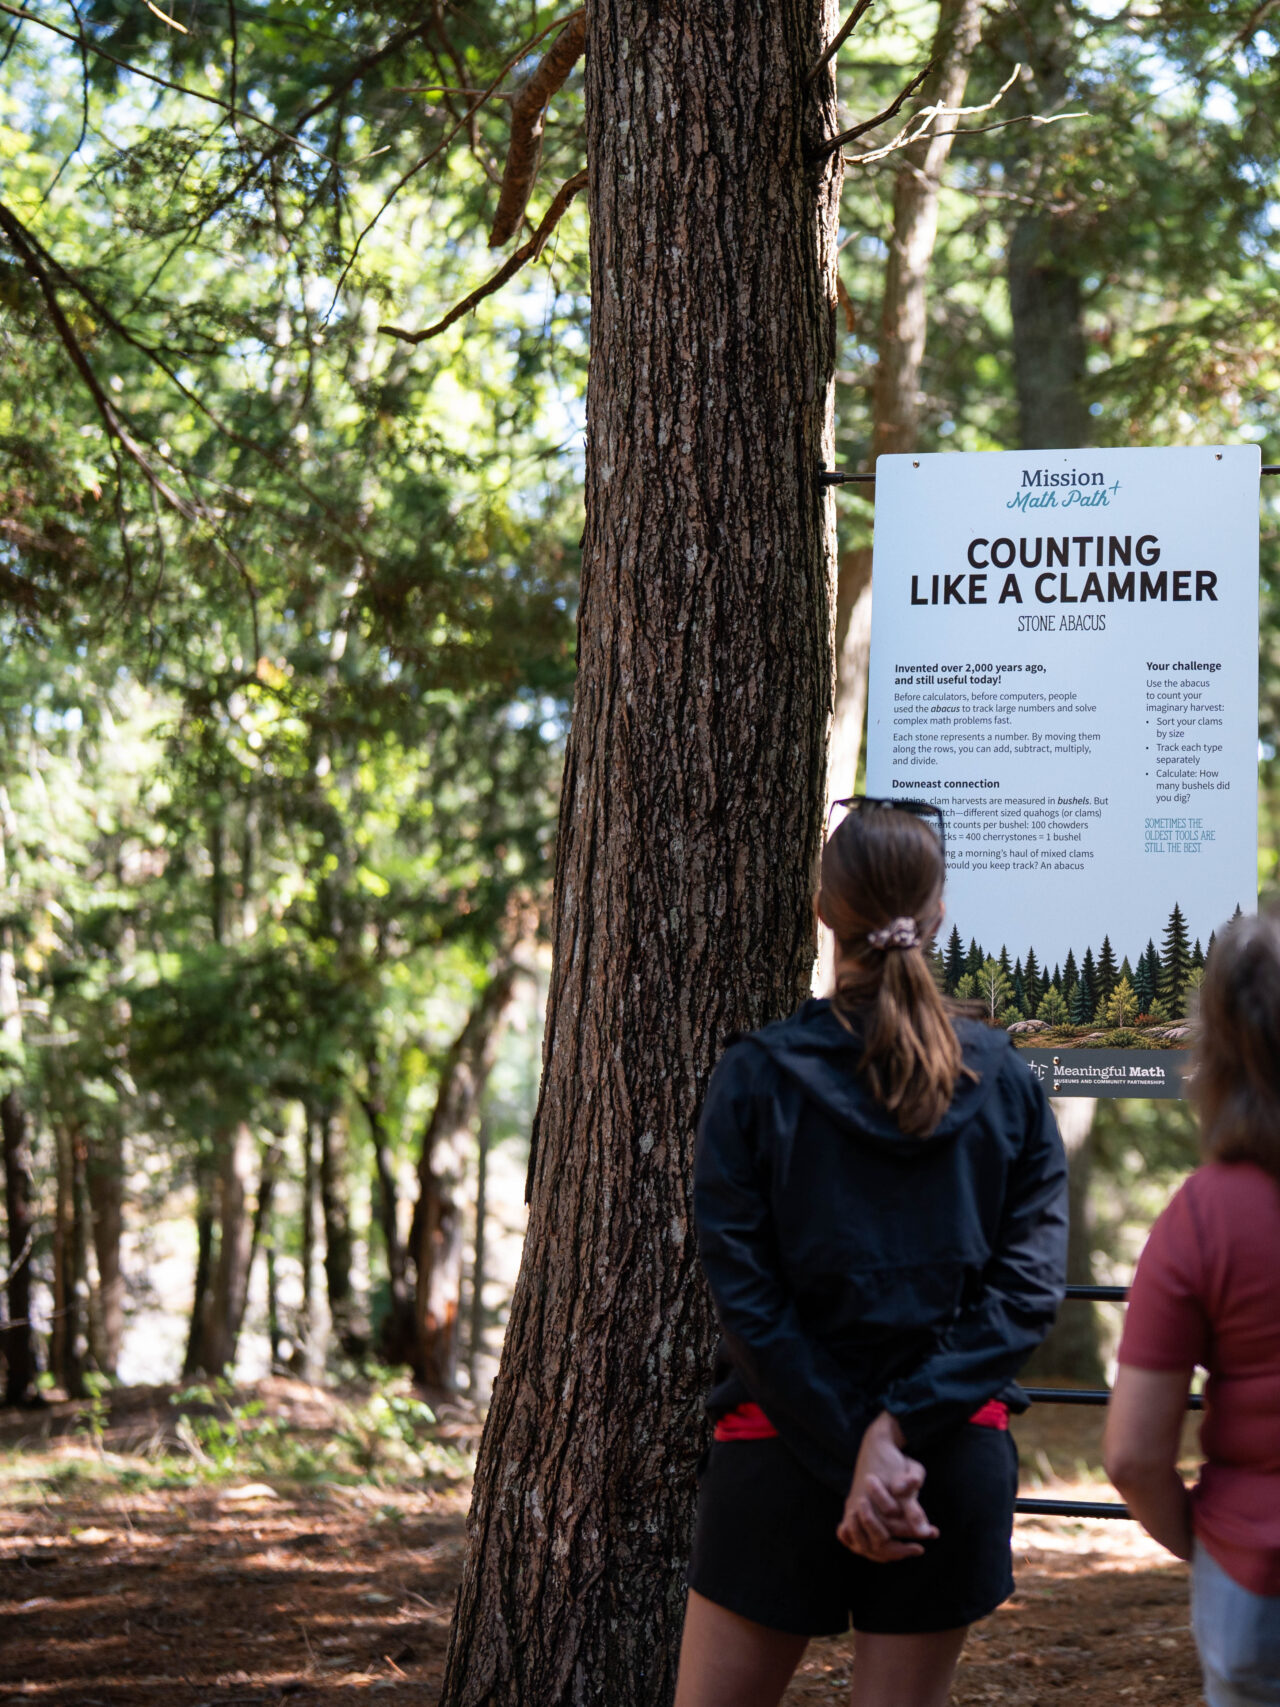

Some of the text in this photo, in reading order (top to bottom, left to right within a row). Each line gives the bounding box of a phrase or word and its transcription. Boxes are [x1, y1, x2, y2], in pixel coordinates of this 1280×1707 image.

[1021, 469, 1104, 487] Mission
[1007, 491, 1058, 513] Math
[968, 535, 1160, 569] COUNTING
[911, 571, 1218, 605] LIKE A CLAMMER
[1018, 615, 1105, 631] STONE ABACUS
[896, 664, 938, 672] Invented
[966, 664, 993, 674] 2,000
[996, 665, 1022, 674] years
[1025, 665, 1046, 674] ago,
[1147, 661, 1221, 672] Your challenge
[895, 675, 1001, 686] and still useful today!
[1164, 679, 1178, 687] the
[1180, 679, 1210, 687] abacus
[895, 692, 1077, 702] Before calculators, before computers, people
[1183, 693, 1202, 701] your
[894, 705, 913, 713] used
[973, 704, 993, 712] track
[996, 704, 1016, 714] large
[1018, 704, 1055, 712] numbers
[1057, 704, 1073, 712] and
[1075, 704, 1096, 712] solve
[1147, 703, 1224, 713] imaginary harvest:
[894, 716, 1011, 726] complex math problems fast.
[1177, 719, 1195, 727] your
[1198, 717, 1222, 725] clams
[894, 733, 912, 741] Each
[941, 734, 985, 742] represents
[995, 732, 1029, 740] number.
[1032, 733, 1042, 742] By
[1045, 732, 1076, 742] moving
[1157, 729, 1184, 739] by size
[893, 745, 916, 755] along
[918, 745, 931, 753] the
[959, 747, 973, 755] you
[994, 744, 1012, 753] add,
[1014, 745, 1052, 753] subtract,
[1055, 744, 1091, 754] multiply,
[1157, 743, 1222, 753] Track each type
[911, 757, 937, 765] divide.
[1157, 755, 1200, 765] separately
[1156, 769, 1197, 777] Calculate:
[893, 779, 999, 788] Downeast connection
[1157, 783, 1179, 791] many
[1182, 781, 1214, 789] bushels
[1005, 797, 1045, 805] measured
[1058, 797, 1091, 805] bushels.
[1094, 797, 1108, 805] But
[1156, 793, 1190, 804] you dig?
[1001, 809, 1021, 817] sized
[1024, 809, 1059, 819] quahogs
[1062, 809, 1073, 818] (or
[1075, 809, 1101, 818] clams)
[999, 821, 1028, 829] bushel:
[1032, 821, 1046, 829] 100
[1048, 821, 1088, 829] chowders
[1145, 818, 1203, 828] SOMETIMES THE
[983, 833, 1037, 842] cherrystones
[1054, 833, 1081, 841] bushel
[1145, 830, 1215, 840] OLDEST TOOLS ARE
[1145, 842, 1202, 852] STILL THE BEST
[1010, 849, 1027, 857] haul
[1030, 849, 1039, 857] of
[1041, 849, 1066, 857] mixed
[972, 863, 987, 871] you
[990, 861, 1010, 871] keep
[1013, 861, 1038, 869] track?
[1054, 861, 1084, 869] abacus
[1053, 1066, 1165, 1079] Meaningful Math
